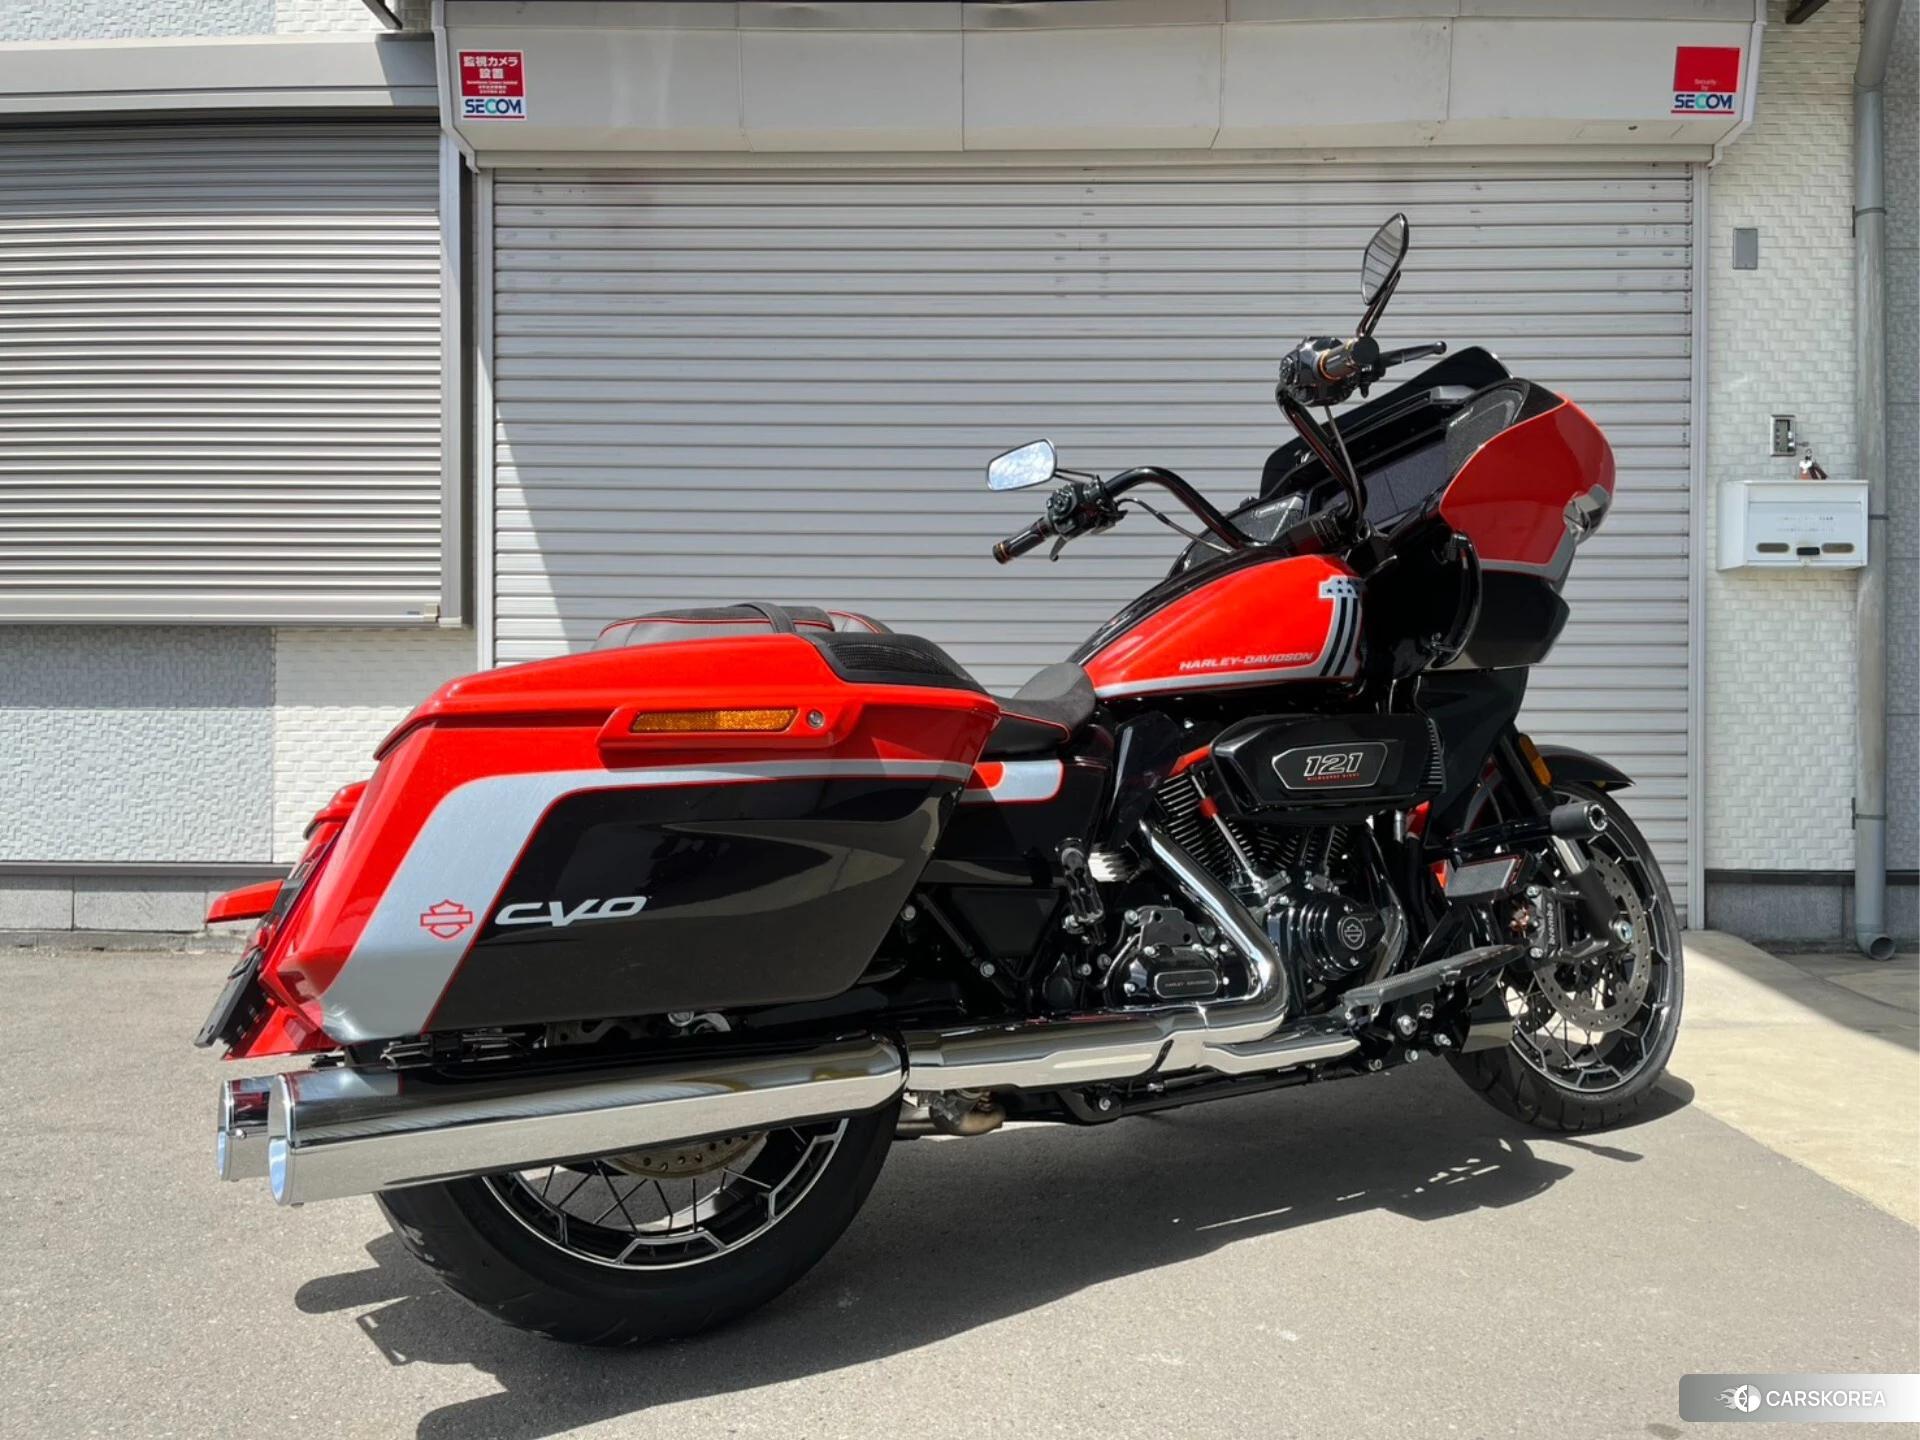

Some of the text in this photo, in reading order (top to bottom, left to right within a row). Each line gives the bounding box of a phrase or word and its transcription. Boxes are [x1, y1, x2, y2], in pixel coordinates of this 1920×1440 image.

[465, 99, 522, 114] SECOM
[1674, 94, 1733, 109] SECOM
[1179, 652, 1315, 671] HARLEY-DAVIDSON
[1303, 752, 1363, 776] 121
[495, 896, 648, 927] CVO
